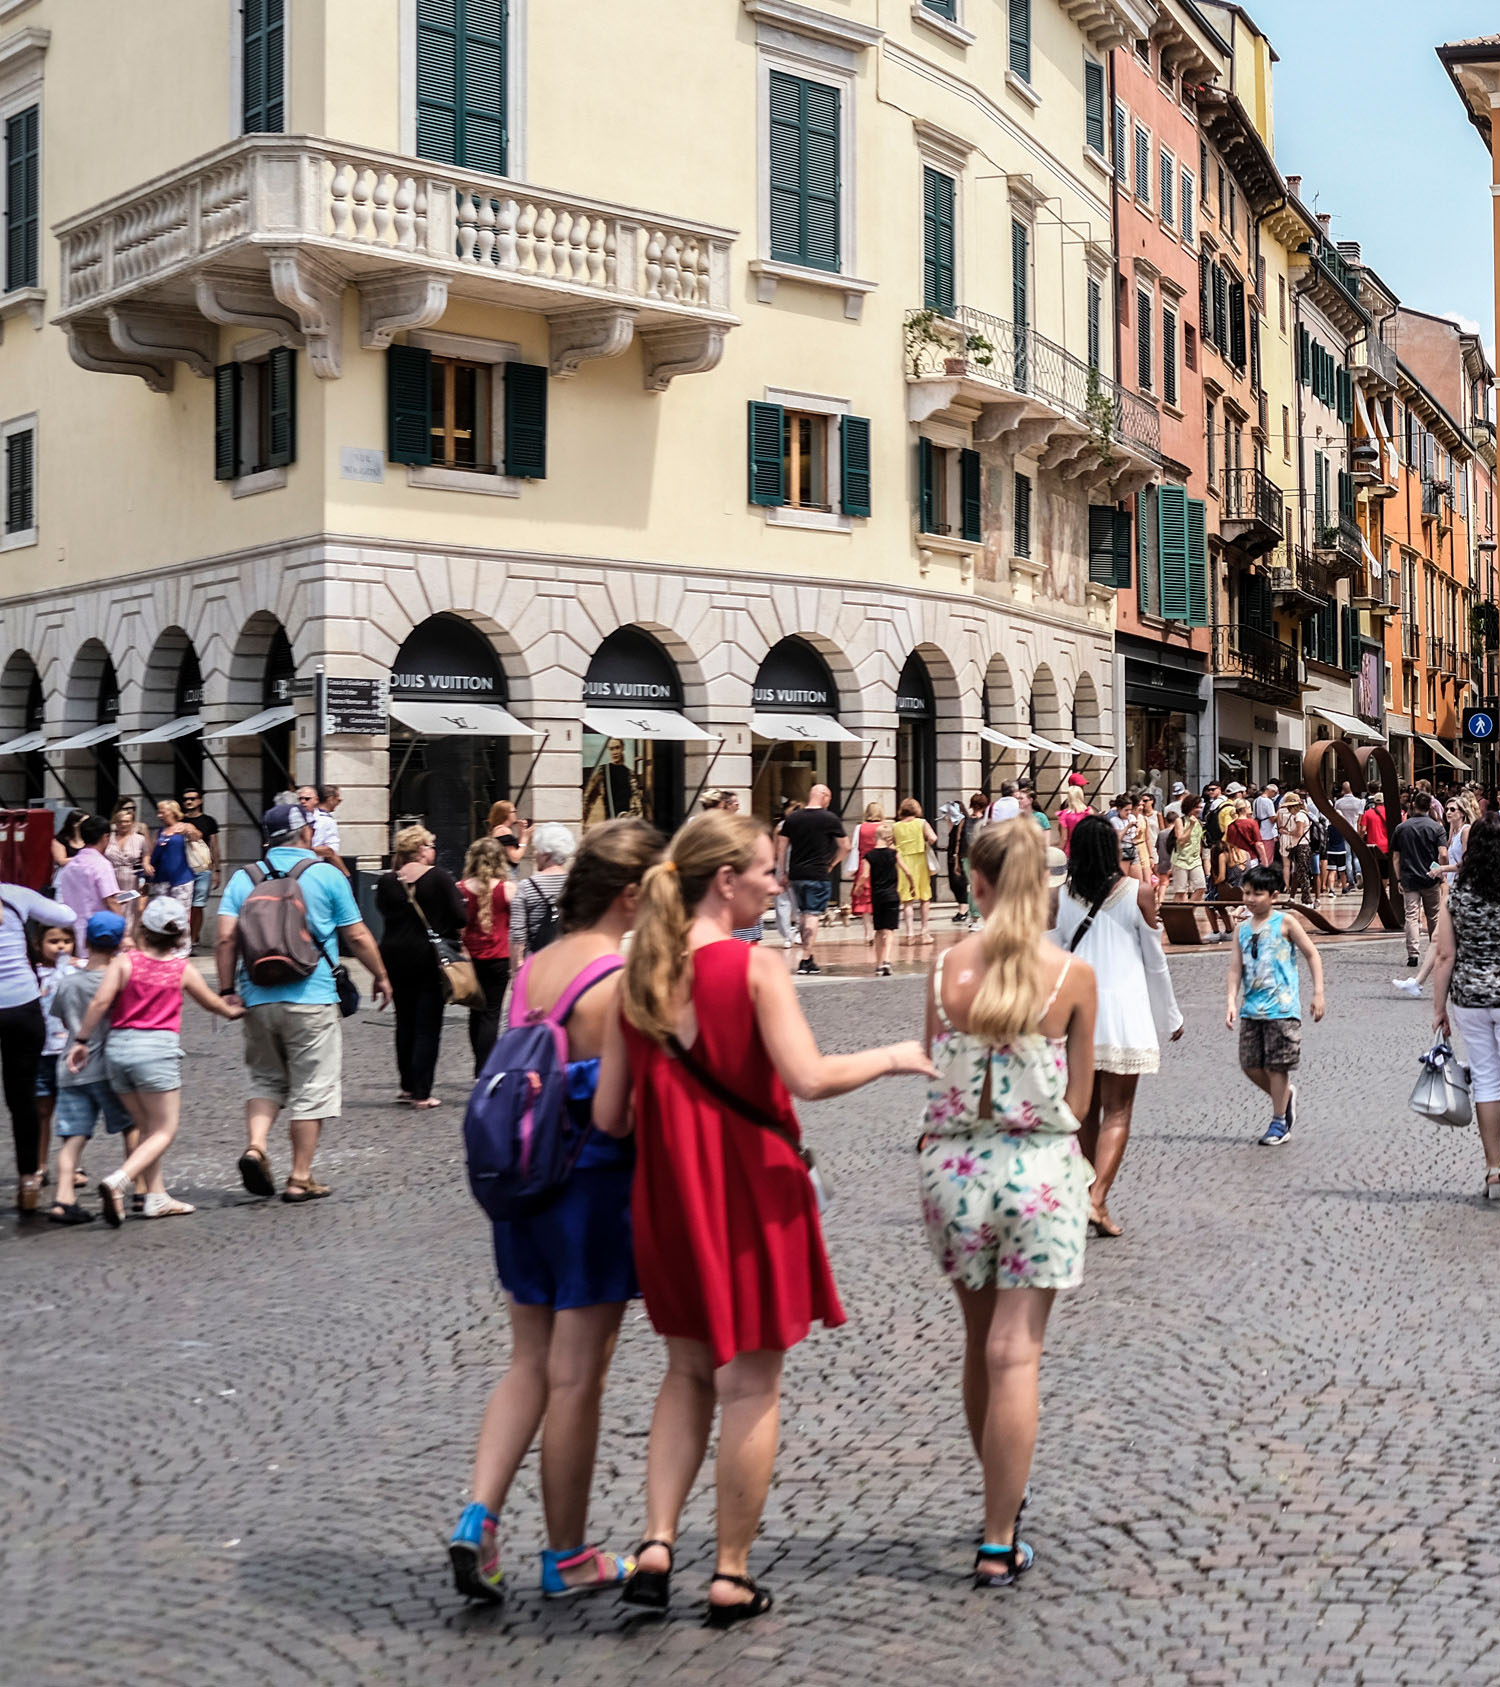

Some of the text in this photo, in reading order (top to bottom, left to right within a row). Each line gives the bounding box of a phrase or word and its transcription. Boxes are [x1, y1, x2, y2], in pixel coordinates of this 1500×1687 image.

[390, 673, 494, 690] OUIS VUITTON
[582, 681, 671, 697] OUIS VUITTON
[752, 689, 827, 703] UIS VUITTON
